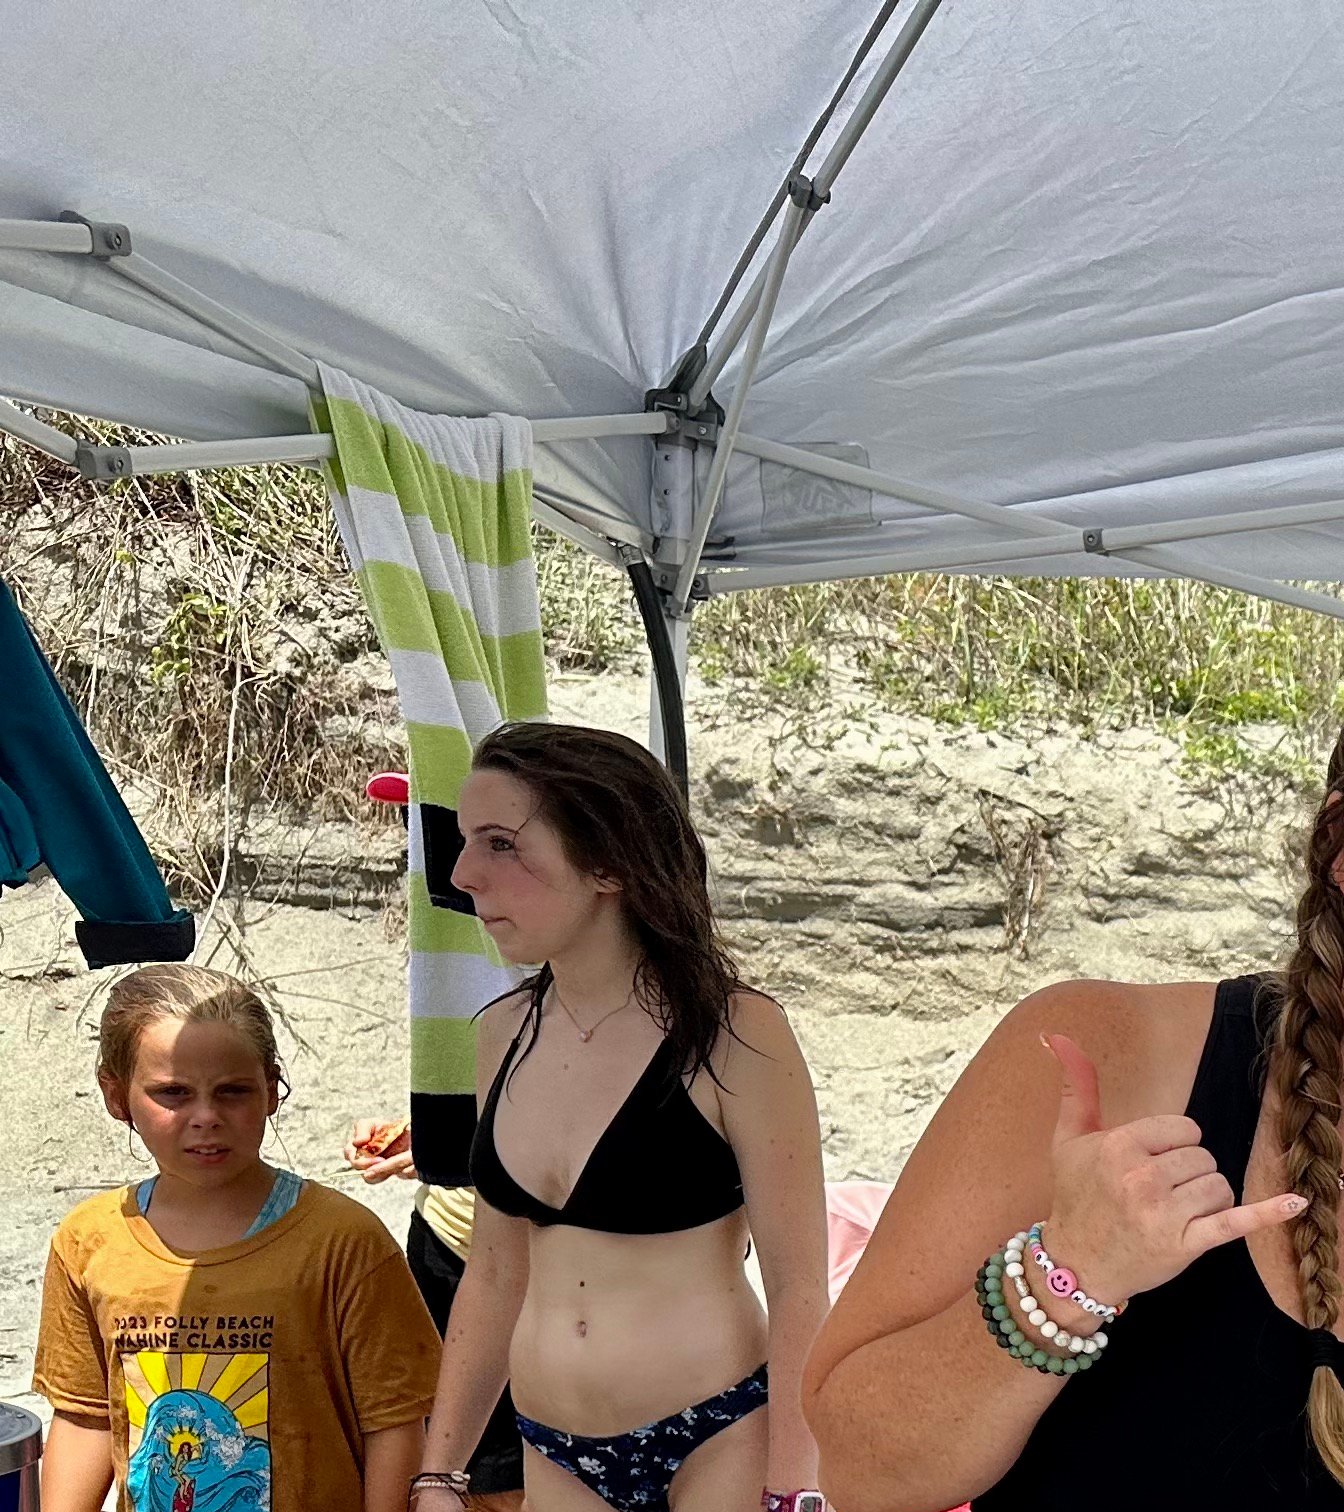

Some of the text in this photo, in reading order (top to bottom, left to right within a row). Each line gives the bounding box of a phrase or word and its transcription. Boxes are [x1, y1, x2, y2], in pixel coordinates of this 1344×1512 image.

[154, 1315, 209, 1330] FOLLY
[216, 1315, 274, 1330] BEACH
[187, 1332, 273, 1349] CLASSIC
